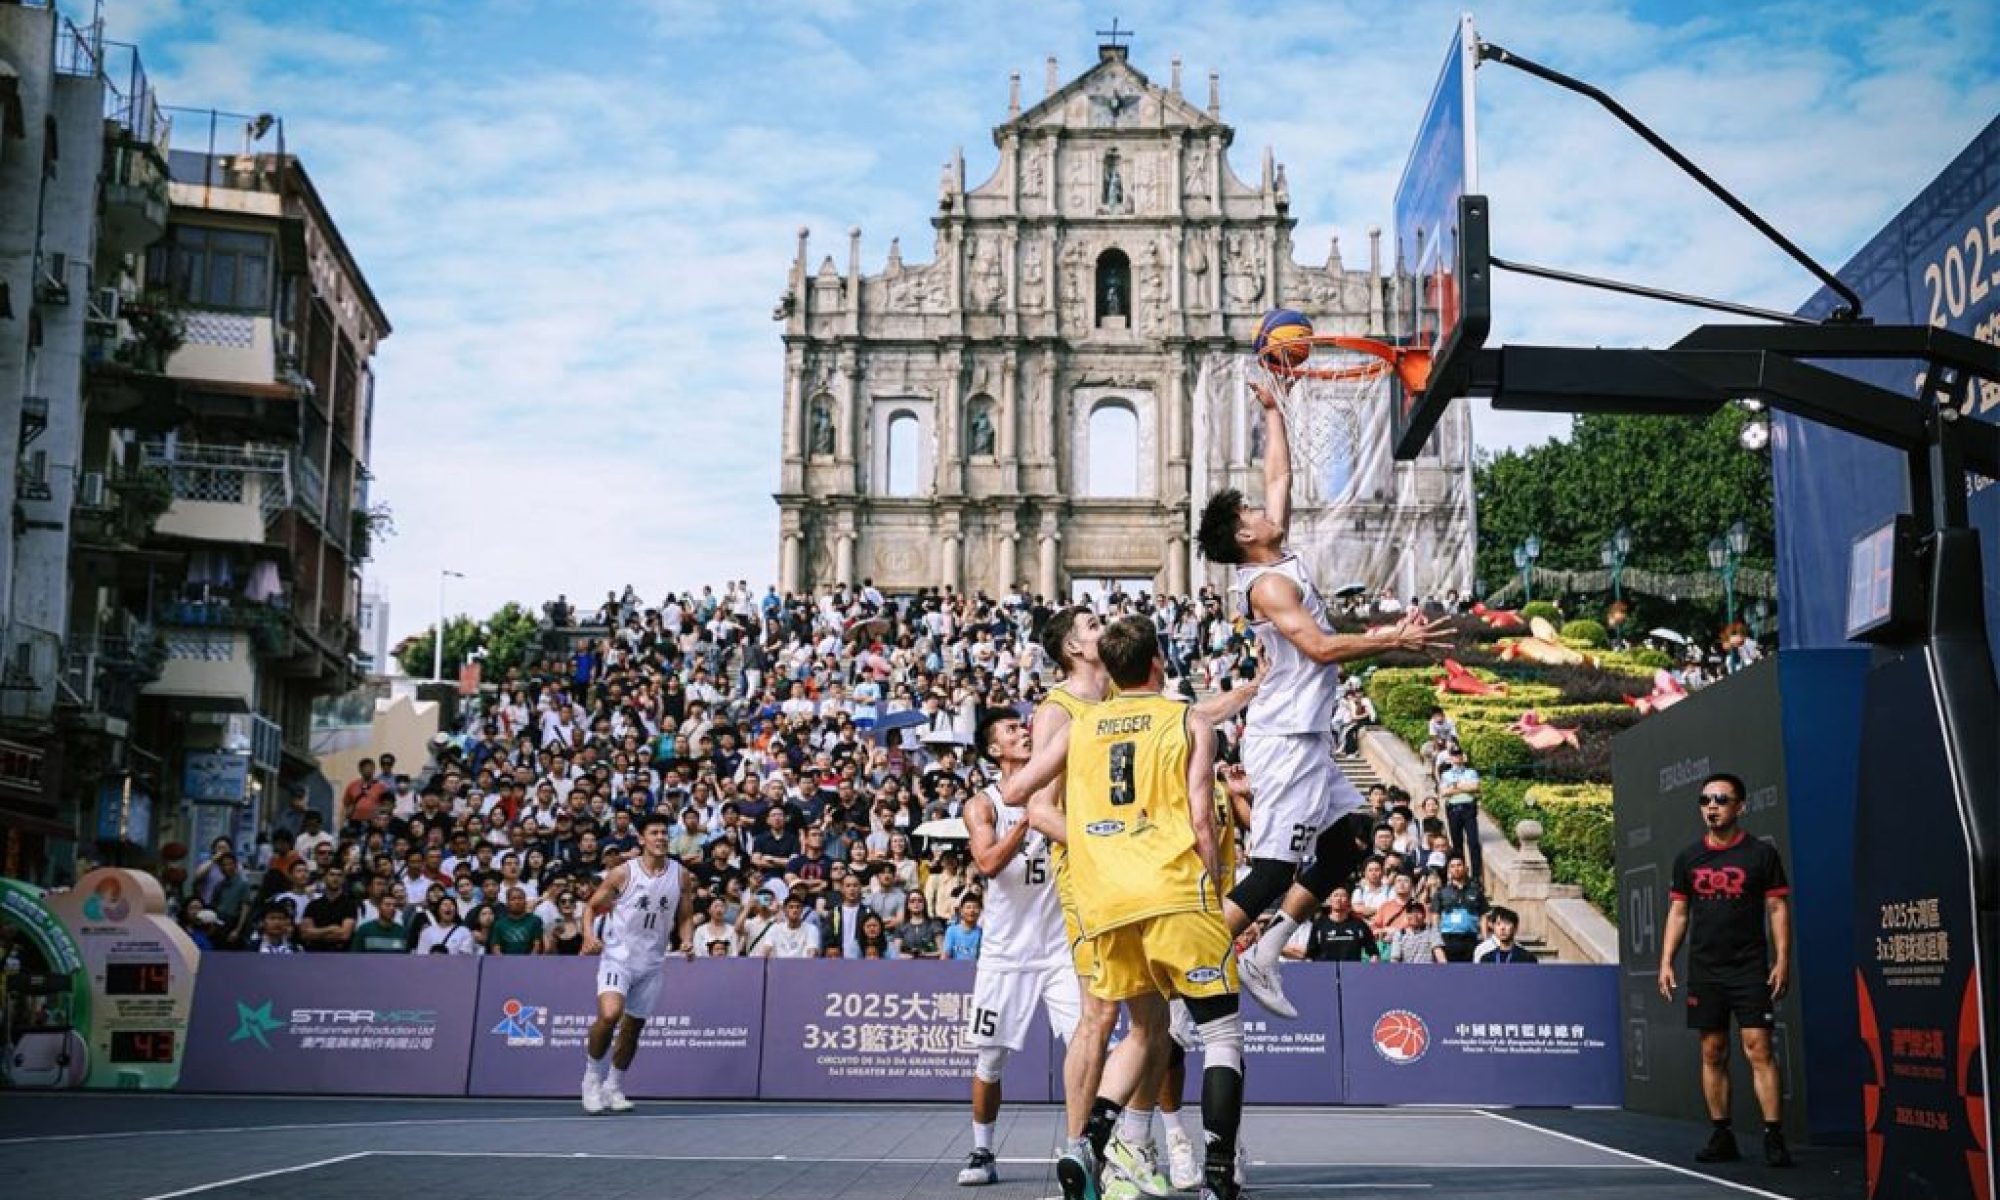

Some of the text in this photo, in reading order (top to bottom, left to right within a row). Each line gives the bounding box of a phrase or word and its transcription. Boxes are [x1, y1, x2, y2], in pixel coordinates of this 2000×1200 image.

[1096, 714, 1152, 735] RIEGER
[1024, 858, 1046, 885] 15
[643, 912, 657, 929] 11
[606, 972, 618, 986] 11
[290, 1009, 437, 1023] STARMAC
[973, 1007, 999, 1037] 15
